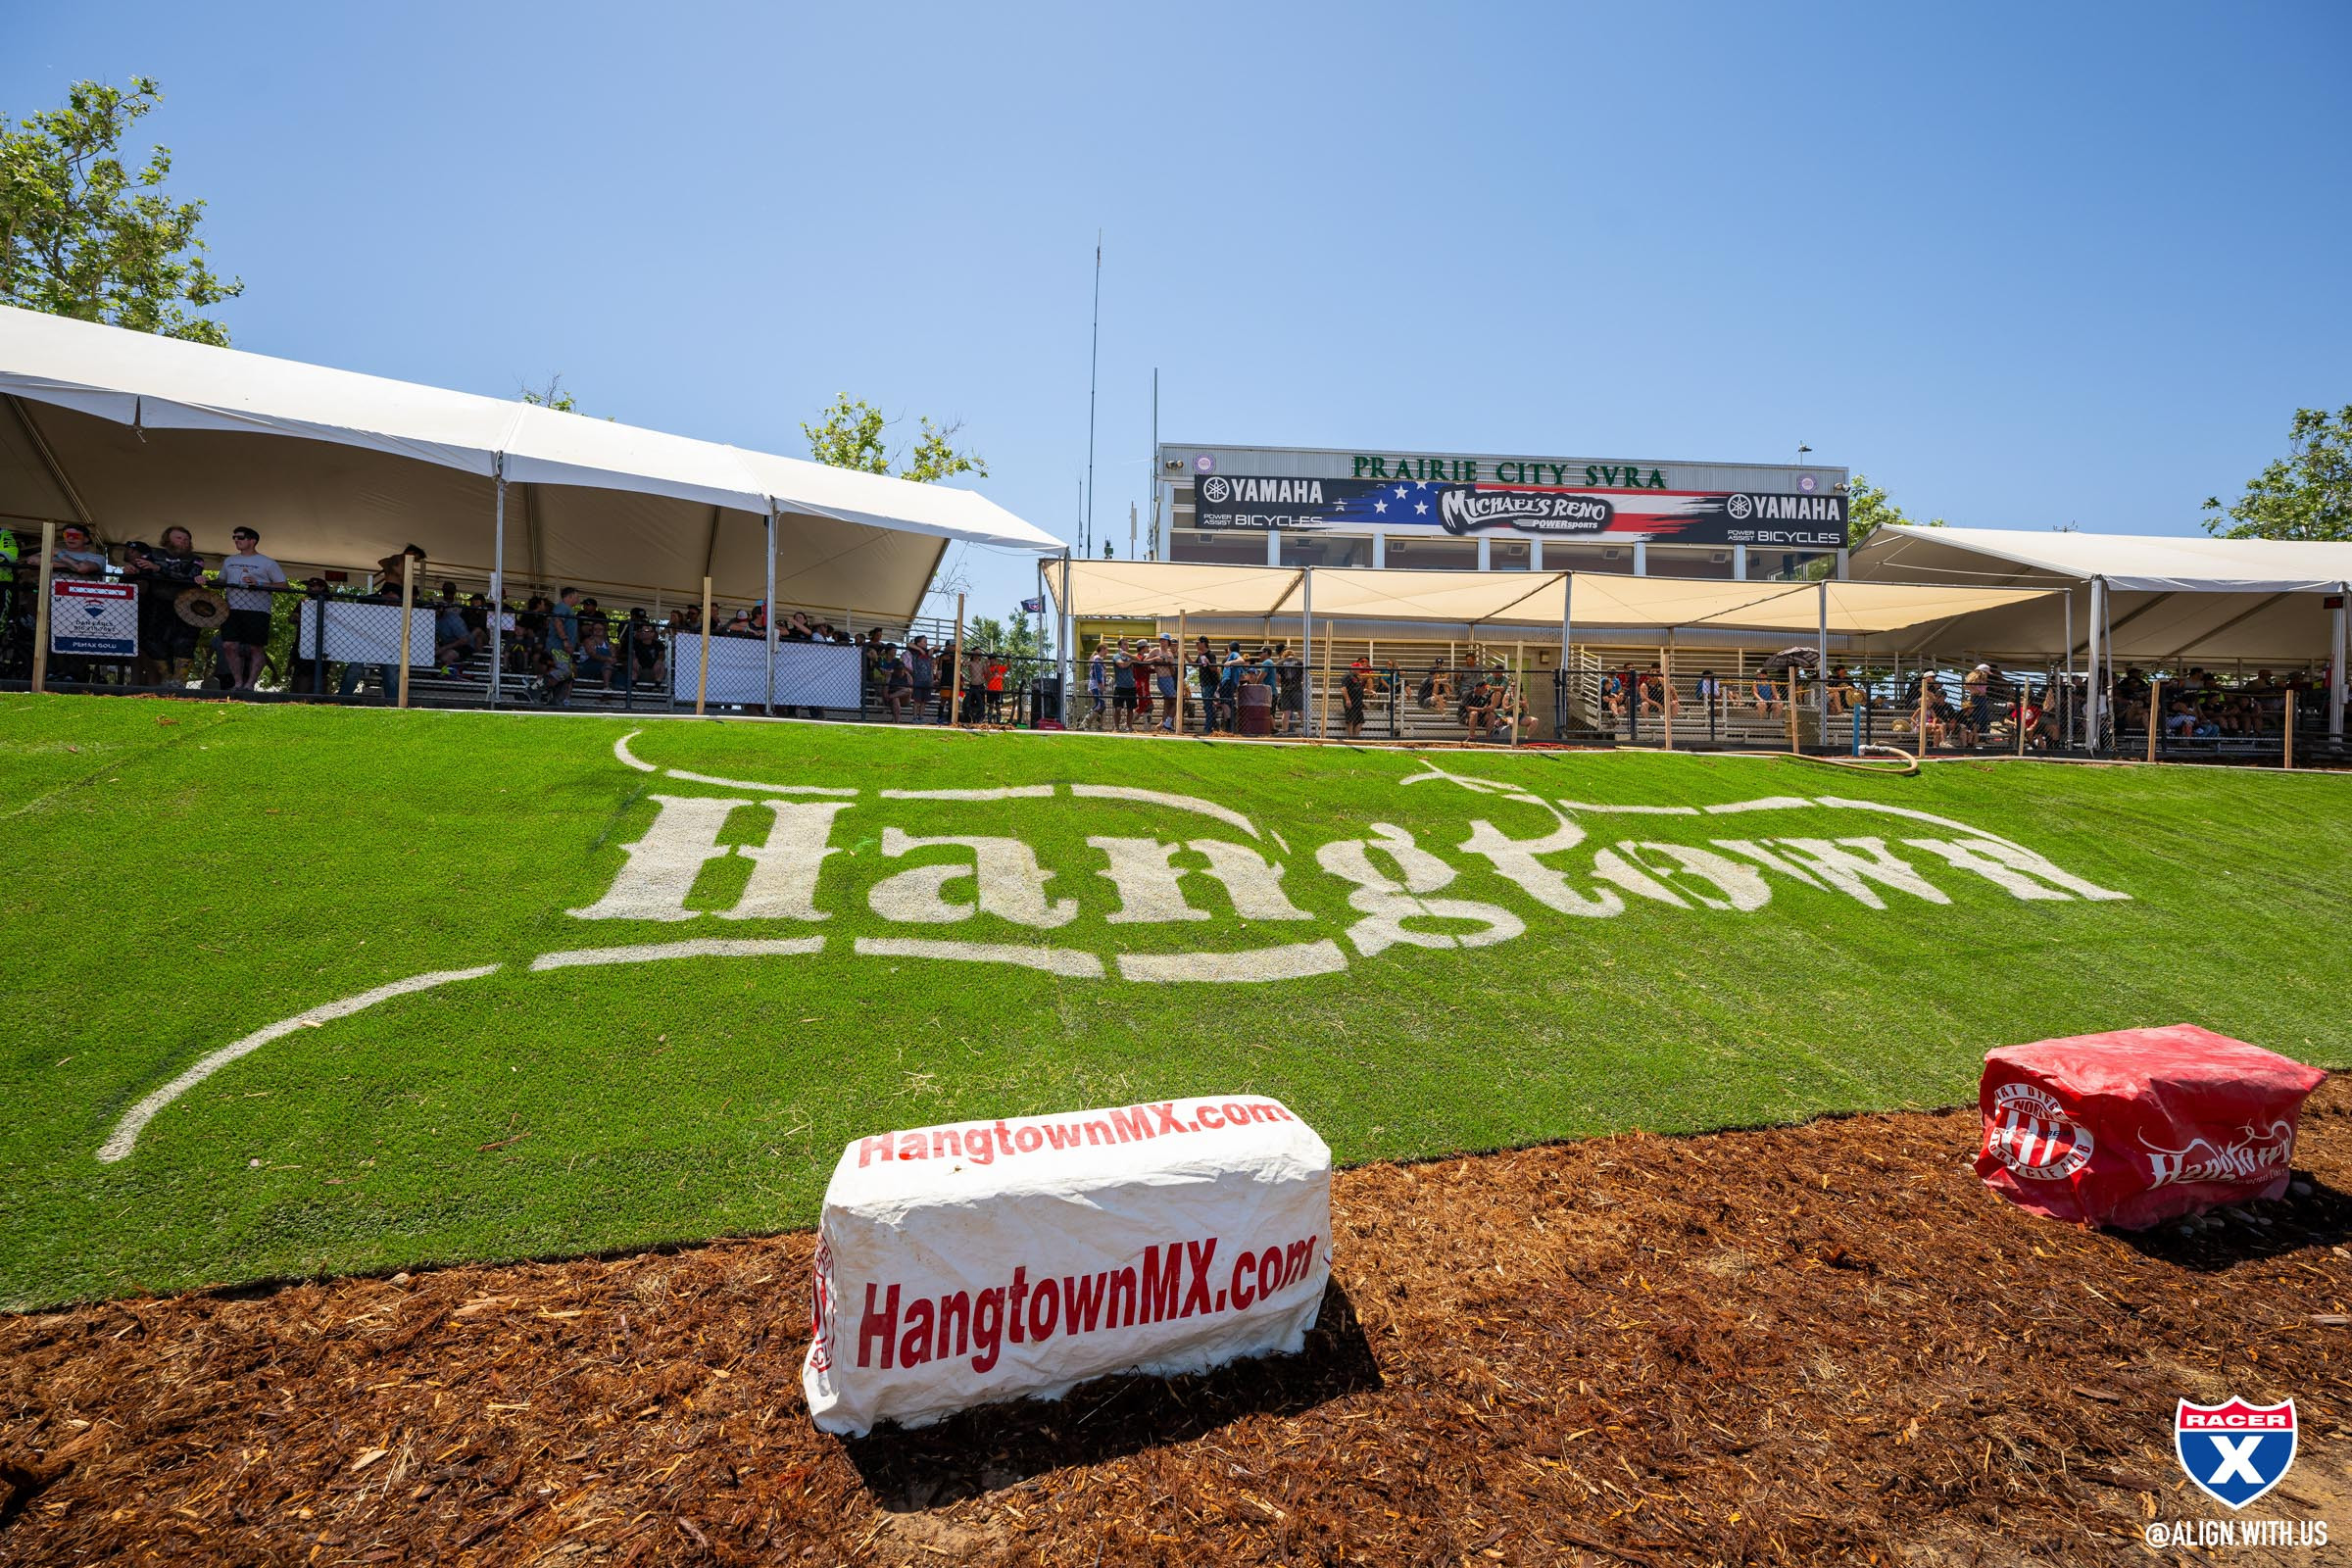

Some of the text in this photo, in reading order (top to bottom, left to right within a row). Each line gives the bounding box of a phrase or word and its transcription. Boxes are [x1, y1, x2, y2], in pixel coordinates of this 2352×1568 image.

[1352, 456, 1667, 489] PRAIRIE CITY SVRA
[1231, 478, 1323, 504] YAMAHA
[1235, 514, 1323, 526] BICYCLES
[1442, 490, 1606, 529] MICHAEL'S RENO
[1753, 496, 1840, 520] YAMAHA
[1758, 530, 1840, 544] BICYCLES
[565, 769, 2132, 958] Hangtown
[858, 1102, 1293, 1167] HangtownMX.com
[857, 1235, 1318, 1374] HangtownMX.com
